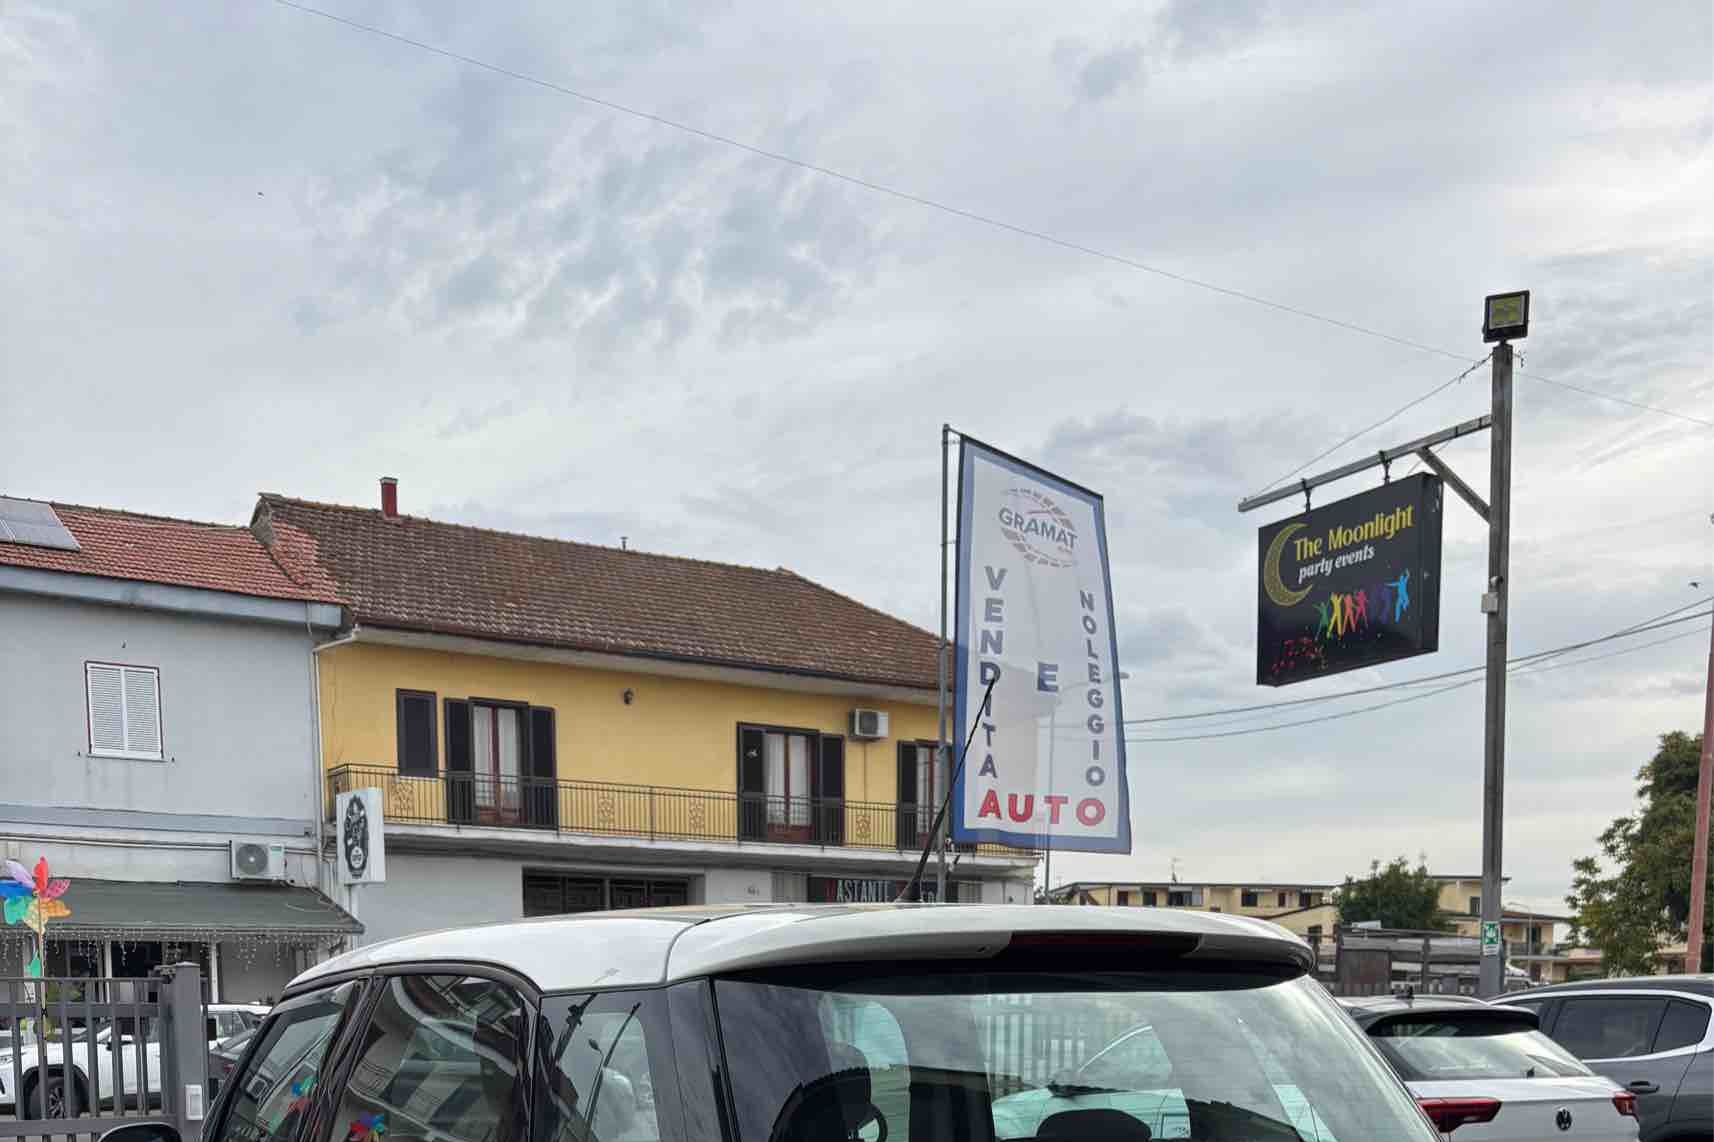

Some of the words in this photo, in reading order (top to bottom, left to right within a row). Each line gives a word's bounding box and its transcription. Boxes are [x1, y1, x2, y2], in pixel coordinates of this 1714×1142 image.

[998, 506, 1078, 549] GRAMAT
[1294, 535, 1322, 561] The
[1328, 504, 1414, 550] Moonlight
[1298, 558, 1334, 584] party
[1335, 545, 1375, 568] events
[1037, 663, 1059, 693] E
[1080, 590, 1106, 787] NOLEGGIO
[978, 789, 1106, 827] AUTO
